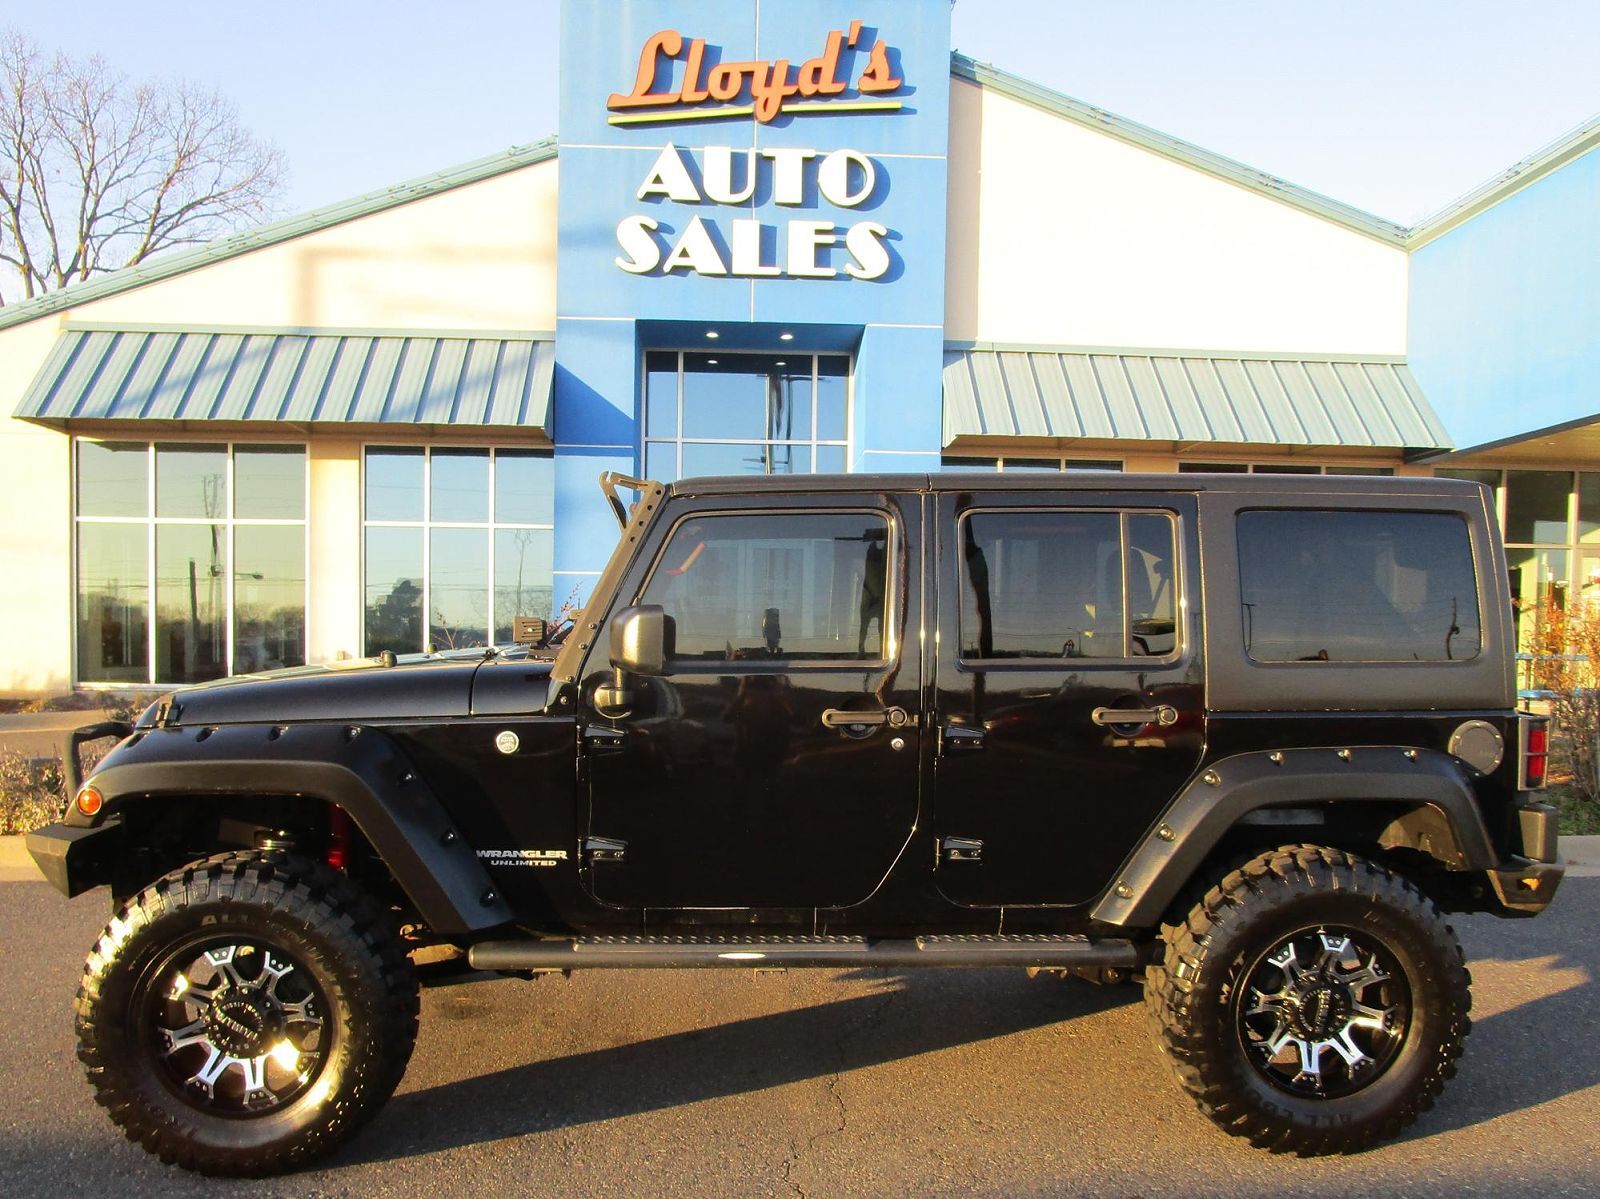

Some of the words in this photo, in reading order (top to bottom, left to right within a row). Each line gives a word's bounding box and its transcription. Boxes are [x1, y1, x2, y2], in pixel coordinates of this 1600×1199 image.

[607, 20, 901, 124] Lloyd's
[637, 141, 876, 207] AUTO
[615, 214, 890, 279] SALES
[476, 850, 568, 860] WRANGLER
